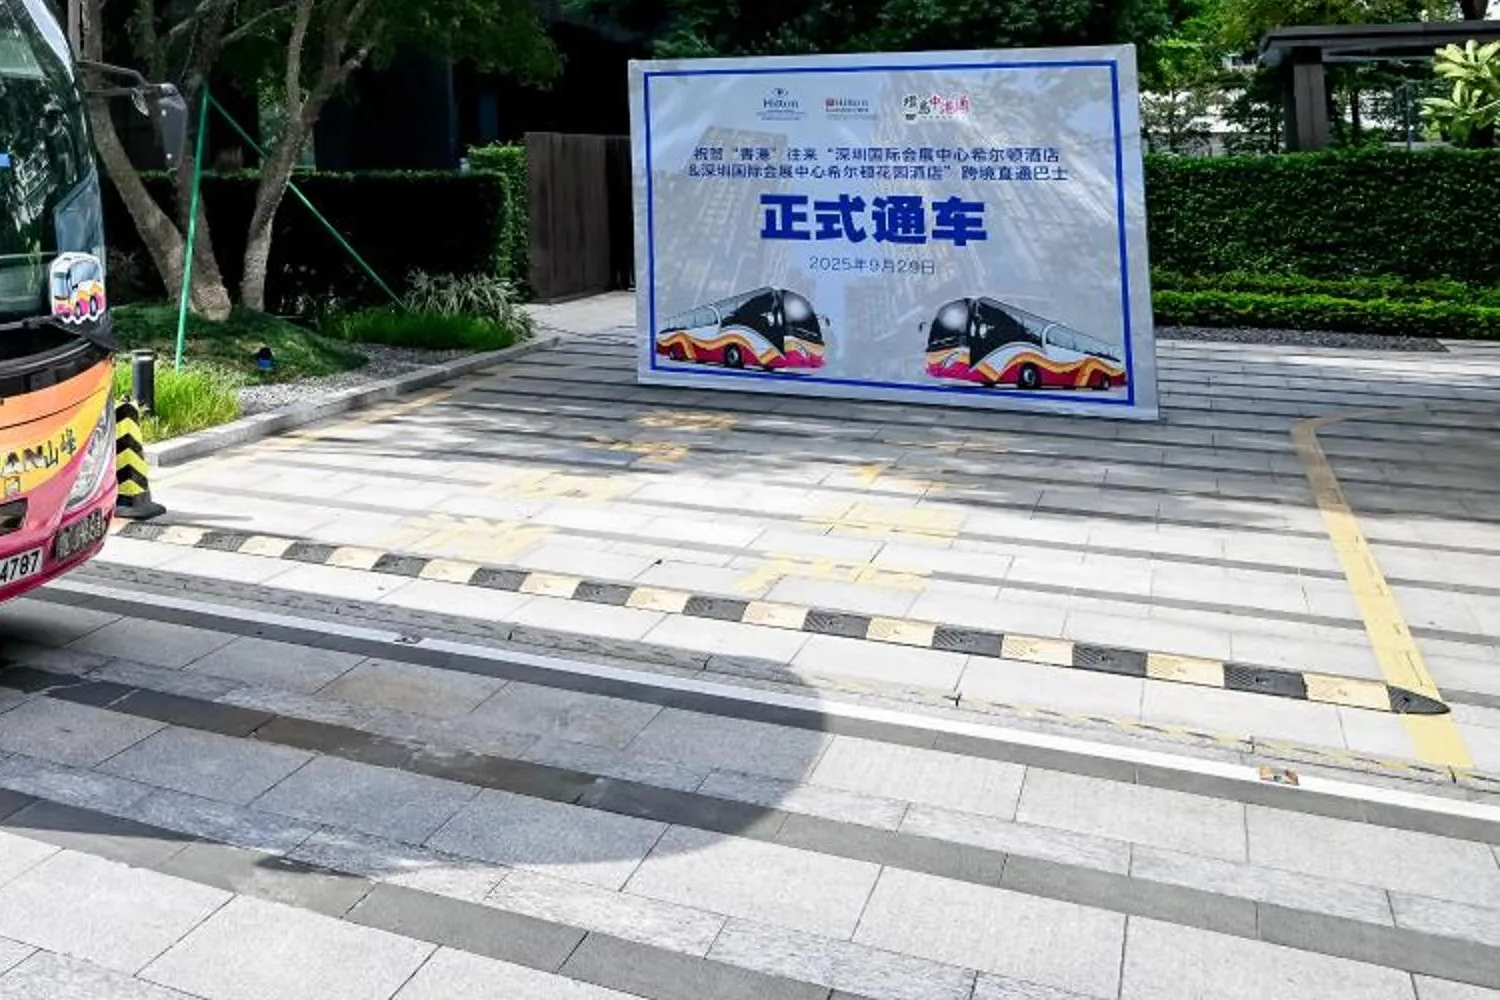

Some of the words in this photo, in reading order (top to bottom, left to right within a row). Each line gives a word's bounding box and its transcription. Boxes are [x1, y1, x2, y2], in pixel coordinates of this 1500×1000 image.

[760, 194, 987, 246] 正式通车
[0, 549, 41, 582] 4787
